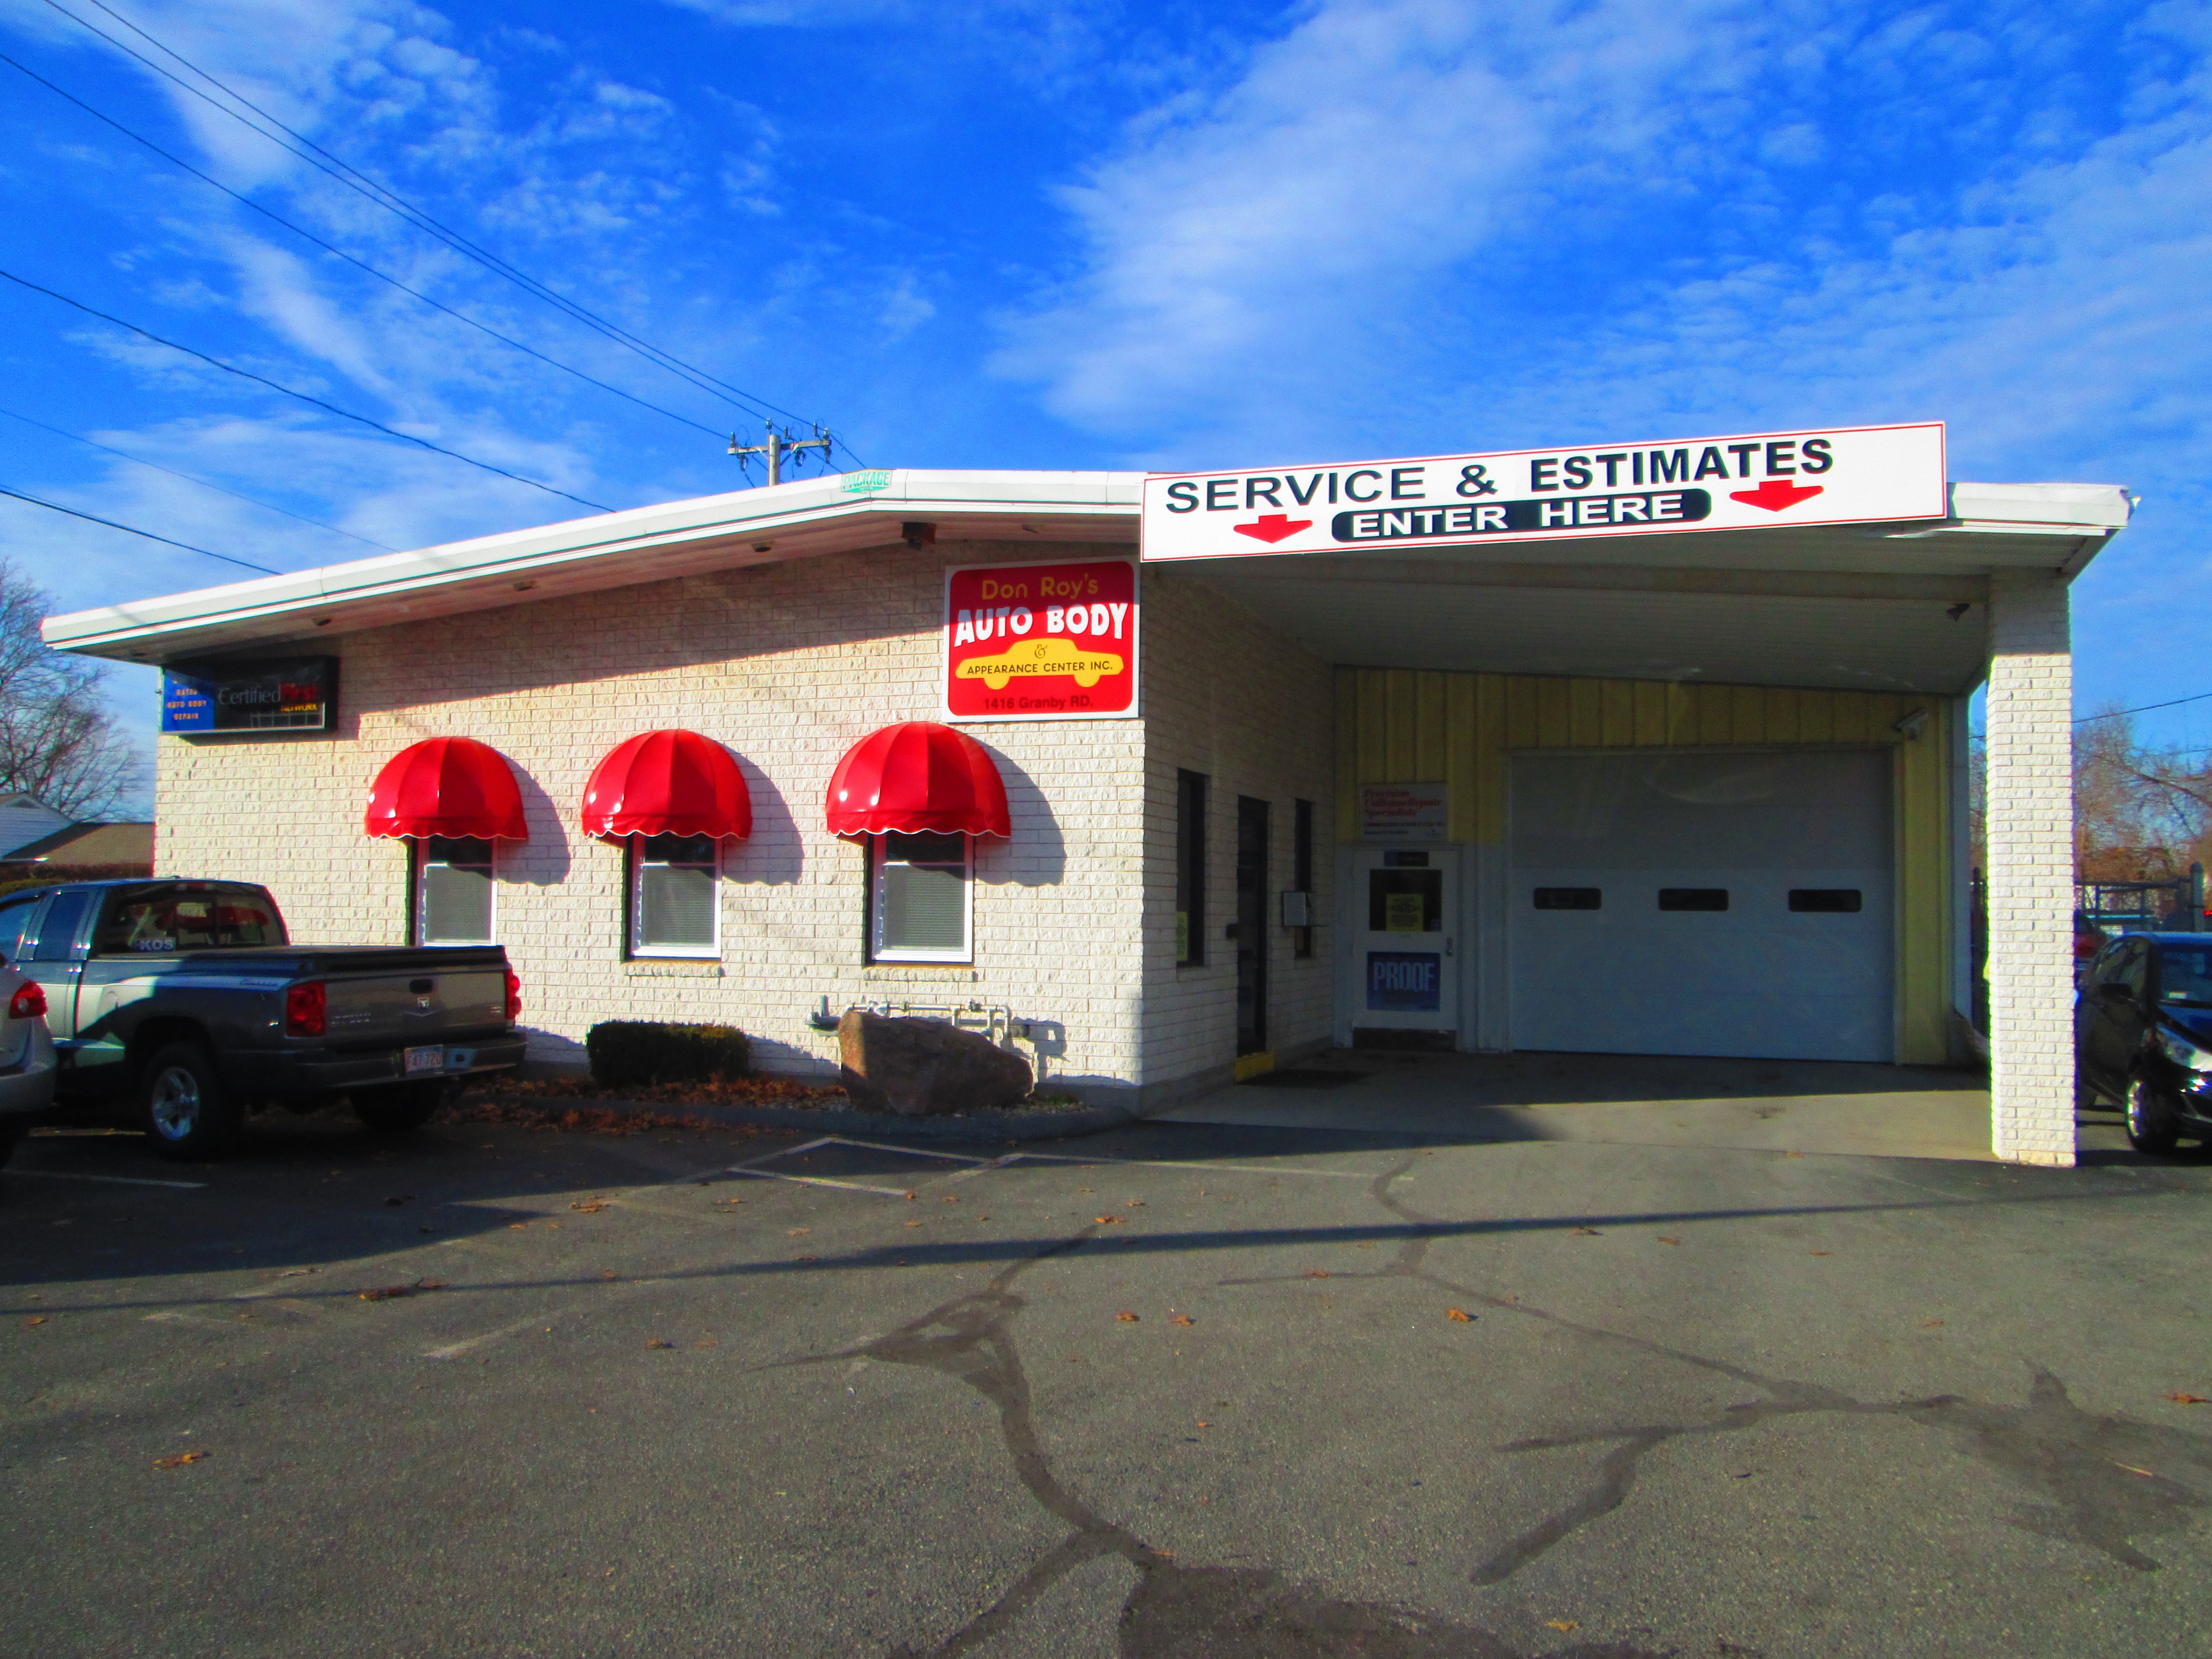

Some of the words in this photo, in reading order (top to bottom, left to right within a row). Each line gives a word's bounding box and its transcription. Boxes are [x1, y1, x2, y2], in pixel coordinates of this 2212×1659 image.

[842, 472, 890, 489] PACKAGE
[1166, 467, 1426, 513] SERVICE
[1456, 464, 1499, 498] &
[1531, 439, 1833, 493] ESTIMATES
[1353, 505, 1508, 538] ENTER
[1541, 493, 1683, 527] HERE
[982, 579, 1028, 600] Don
[1040, 573, 1099, 600] Roy's
[954, 606, 1033, 647] AUTO
[1046, 602, 1128, 639] BODY
[1034, 644, 1047, 659] &
[967, 664, 1038, 674] APPEARANCE
[1044, 662, 1085, 672] CENTER
[1091, 661, 1113, 671] INC.
[984, 697, 1015, 710] 1416
[1019, 697, 1066, 710] Granby
[1071, 695, 1094, 708] RD.
[1373, 962, 1435, 992] PROOF
